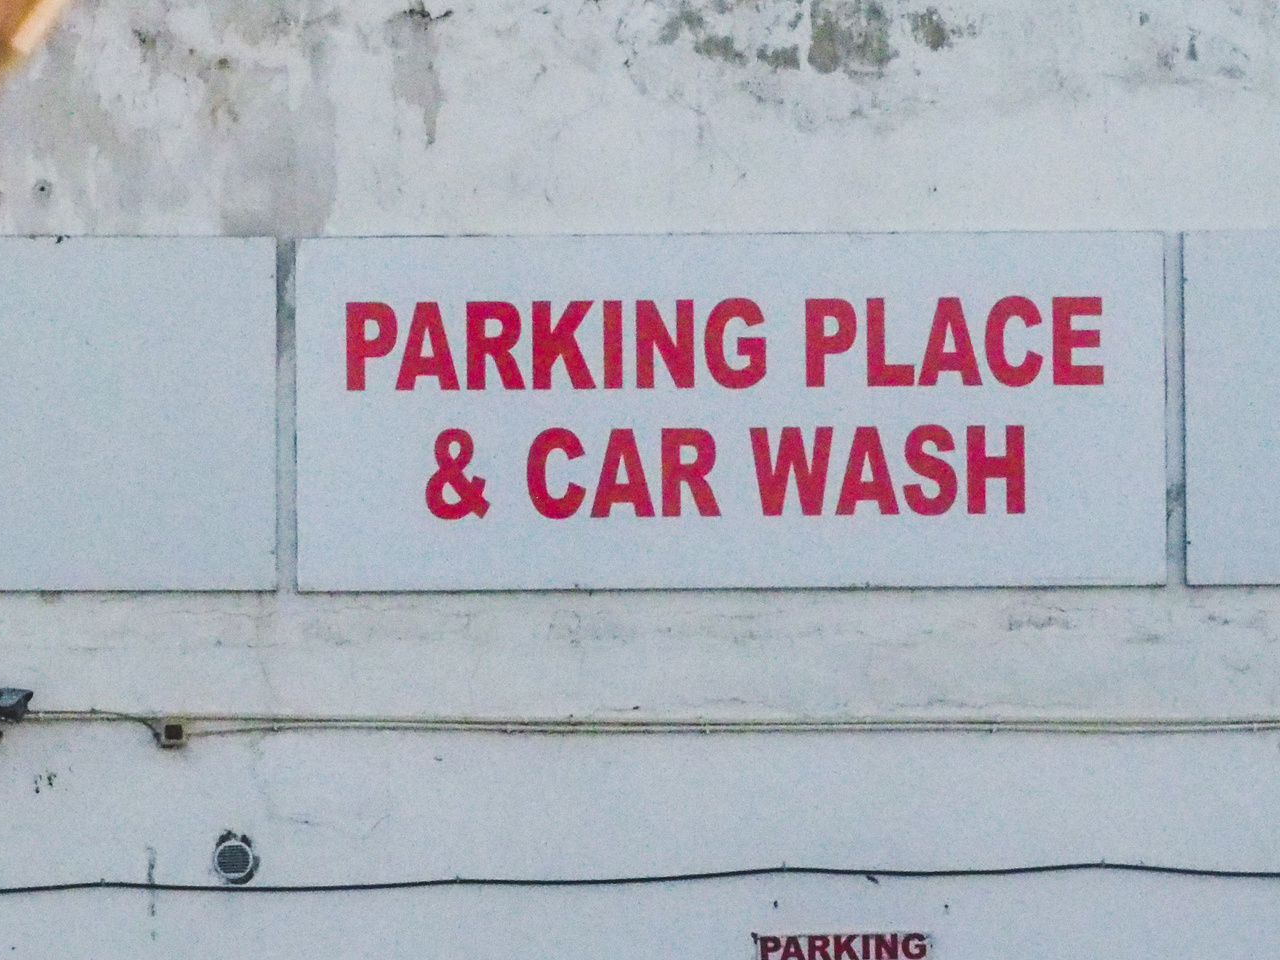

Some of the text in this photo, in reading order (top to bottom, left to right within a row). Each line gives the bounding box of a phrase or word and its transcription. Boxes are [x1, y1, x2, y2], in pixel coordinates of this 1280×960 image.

[345, 295, 1105, 392] PARKING PLACE
[424, 424, 1026, 521] & CAR WASH
